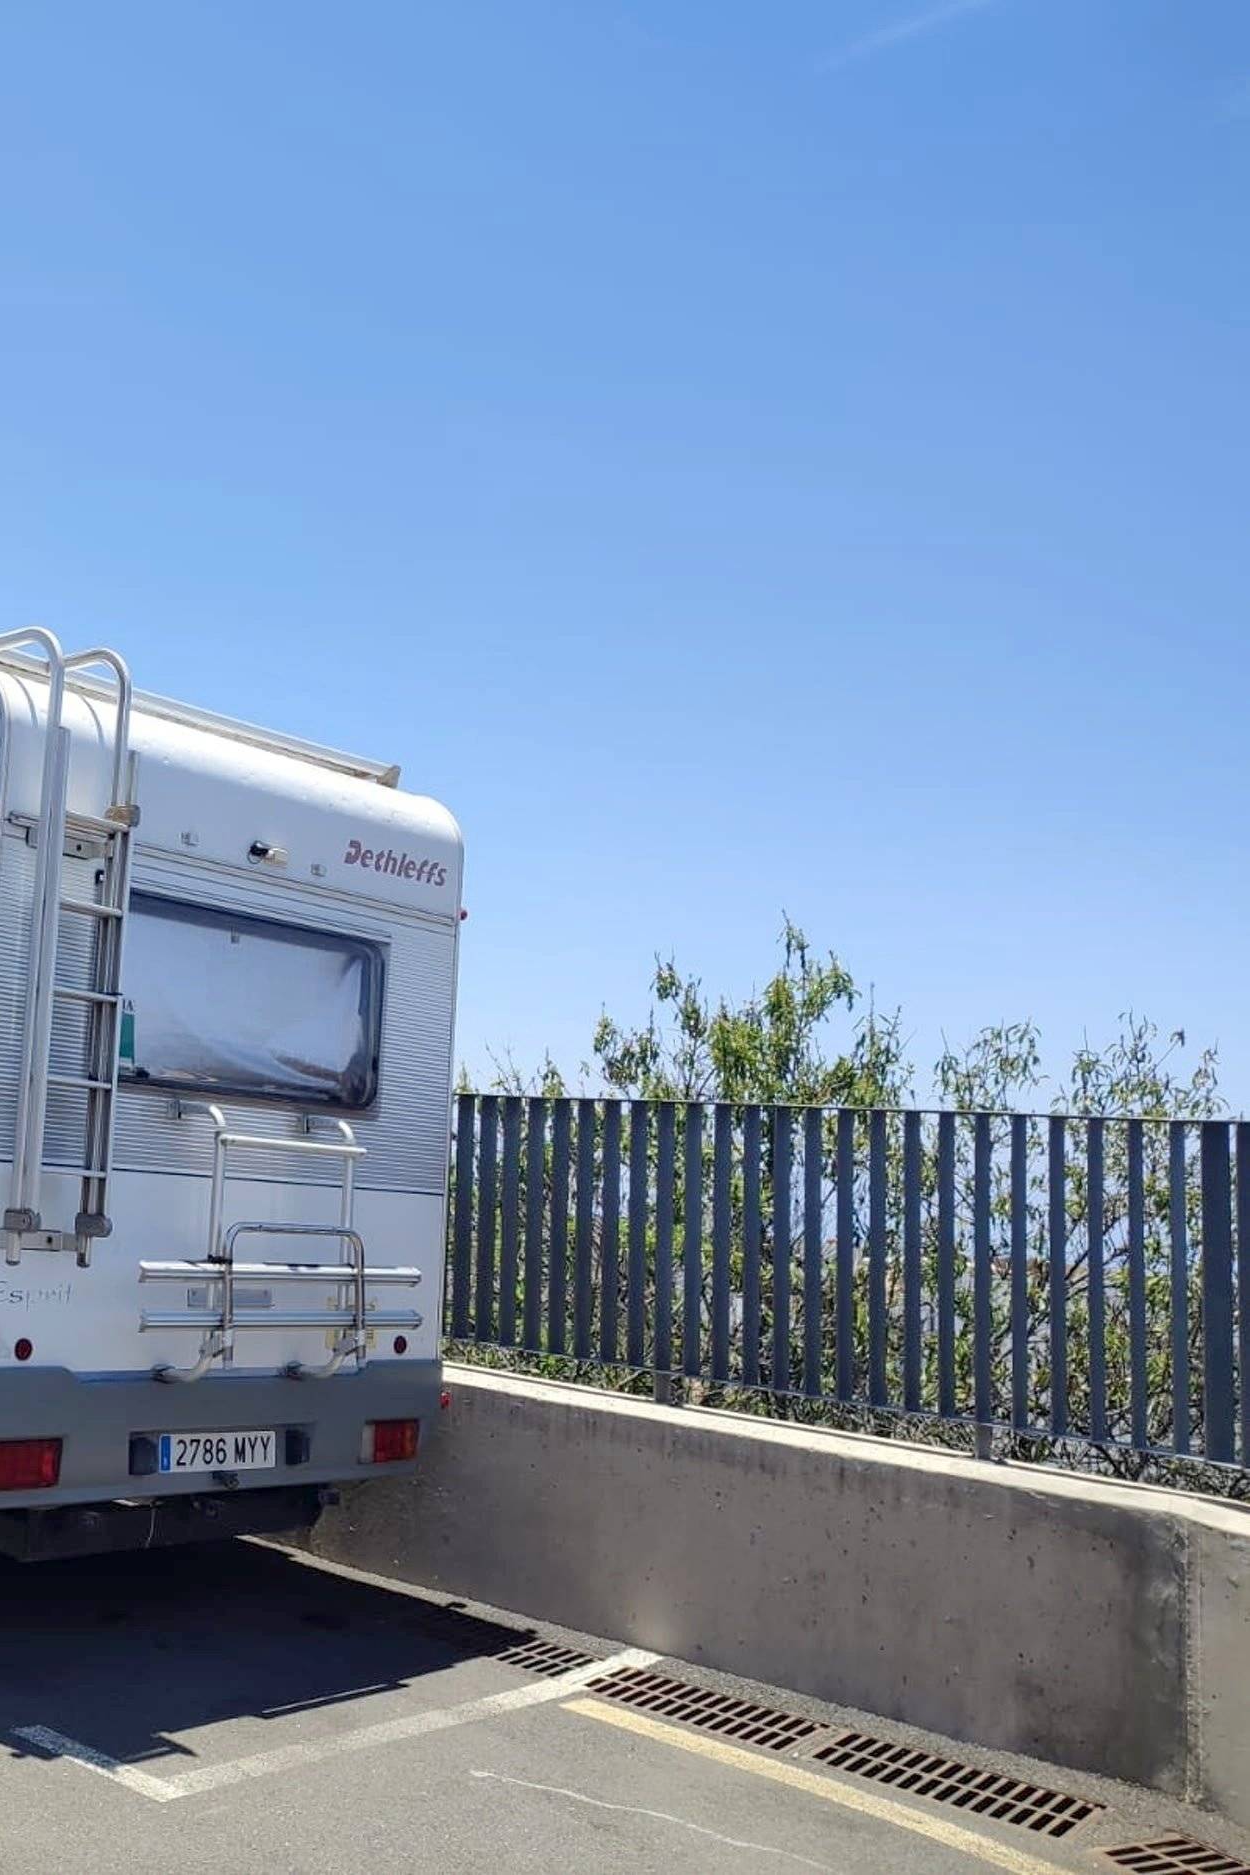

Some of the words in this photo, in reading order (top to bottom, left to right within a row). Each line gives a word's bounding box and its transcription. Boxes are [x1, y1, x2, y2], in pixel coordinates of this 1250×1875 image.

[344, 840, 447, 887] Dethleffs
[176, 1438, 227, 1466] 2786
[234, 1436, 270, 1463] MYY
